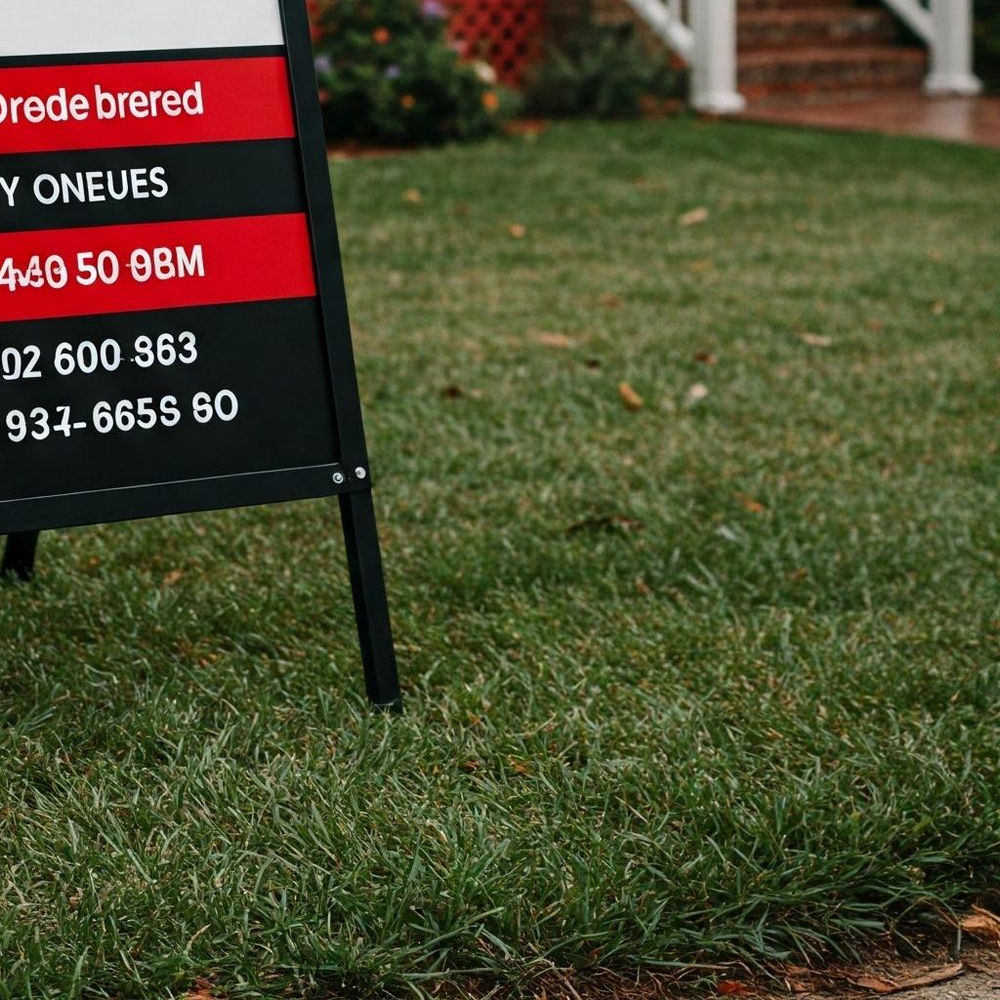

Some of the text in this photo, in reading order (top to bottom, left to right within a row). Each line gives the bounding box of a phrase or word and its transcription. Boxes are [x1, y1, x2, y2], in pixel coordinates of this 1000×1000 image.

[94, 80, 204, 120] brered
[33, 166, 169, 205] ONEUES
[75, 249, 120, 286] 50
[53, 338, 121, 376] 600
